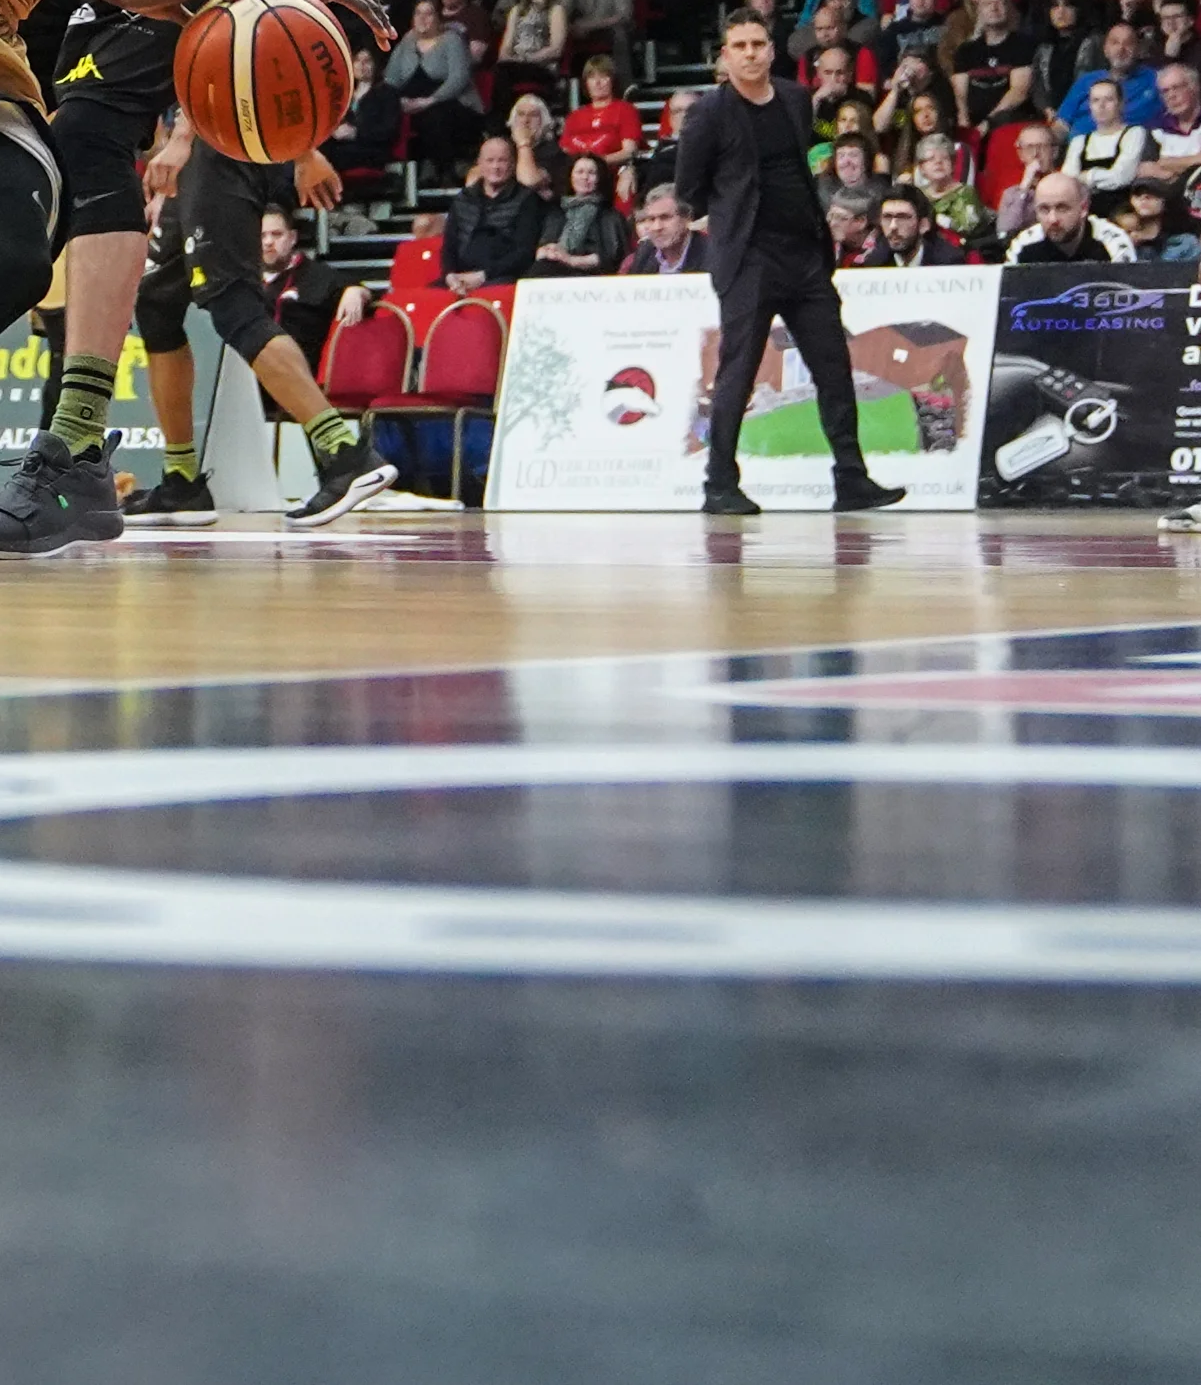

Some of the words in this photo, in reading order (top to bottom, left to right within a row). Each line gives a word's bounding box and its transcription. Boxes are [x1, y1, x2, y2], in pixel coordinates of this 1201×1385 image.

[526, 288, 611, 305] DESIGNING
[614, 288, 628, 303] &
[633, 285, 708, 302] BUILDING
[857, 279, 910, 296] GREAT
[915, 276, 986, 294] COUNTY
[1073, 292, 1132, 308] 360
[1011, 317, 1165, 331] AUTOLEASING
[515, 459, 558, 489] LGD
